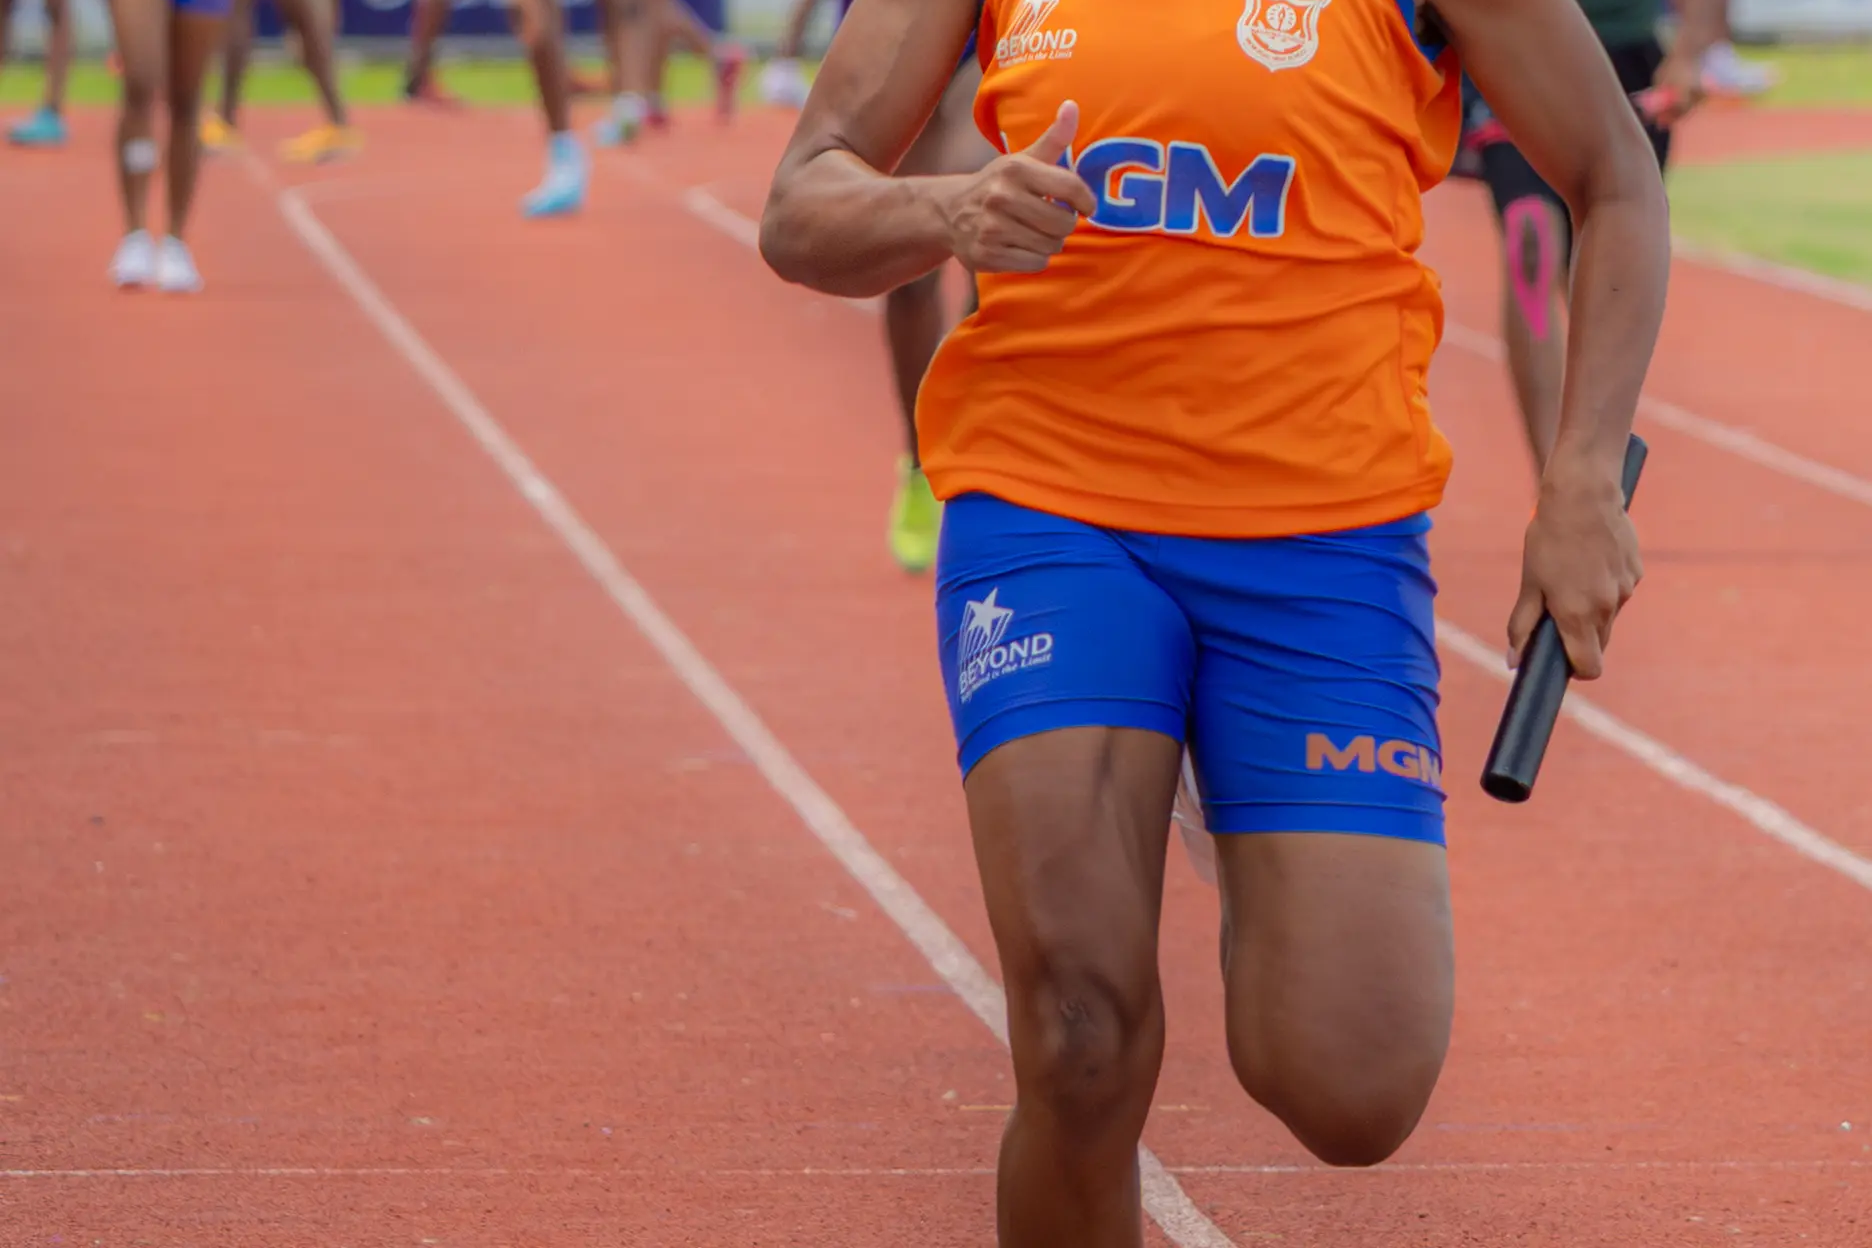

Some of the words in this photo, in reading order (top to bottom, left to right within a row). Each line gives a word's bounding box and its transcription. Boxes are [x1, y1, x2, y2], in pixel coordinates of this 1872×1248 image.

[996, 28, 1077, 59] BEYOND
[1000, 132, 1296, 237] GM
[960, 633, 1053, 694] BEYOND
[1021, 652, 1052, 668] Limit
